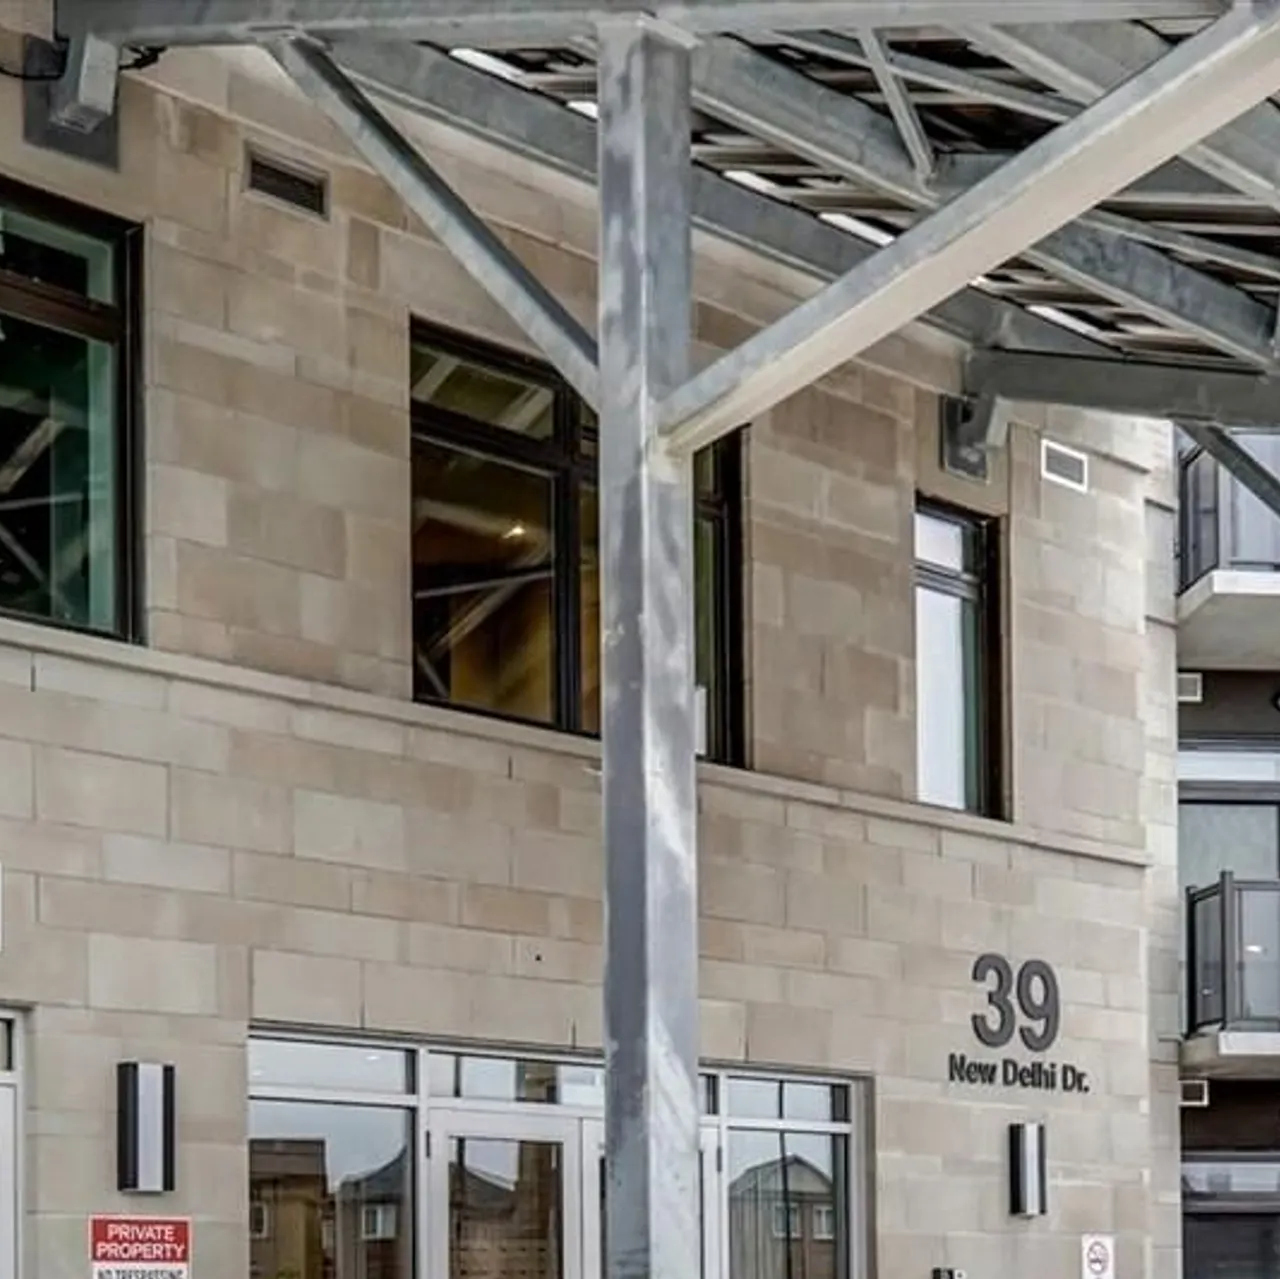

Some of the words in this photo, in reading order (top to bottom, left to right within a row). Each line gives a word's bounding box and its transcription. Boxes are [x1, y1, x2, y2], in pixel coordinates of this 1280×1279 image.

[971, 953, 1059, 1052] 39
[948, 1053, 998, 1085] New
[1002, 1058, 1057, 1091] Delhi
[1062, 1064, 1090, 1093] Dr.
[107, 1224, 176, 1242] PRIVATE
[96, 1241, 185, 1259] PROPERTY
